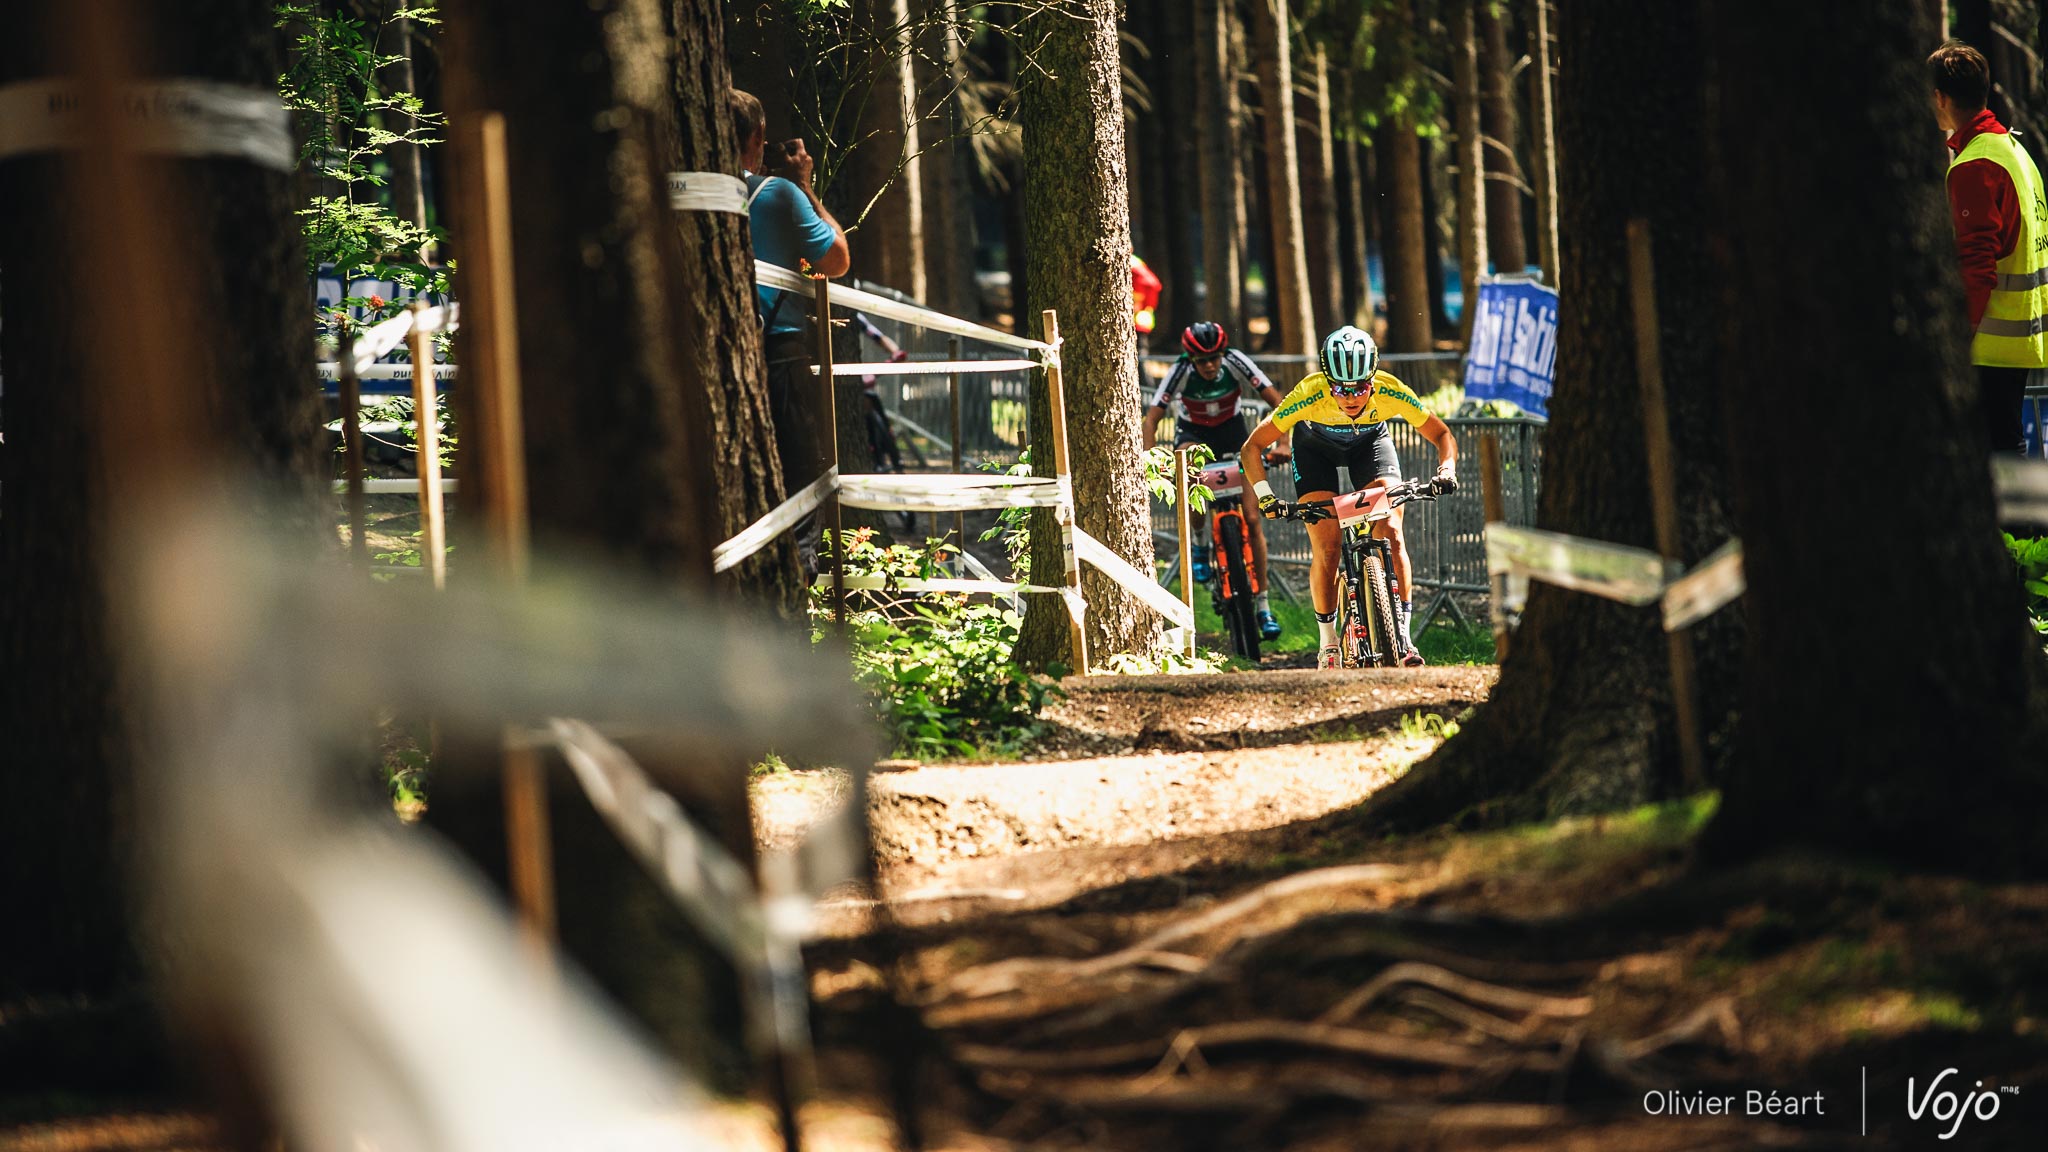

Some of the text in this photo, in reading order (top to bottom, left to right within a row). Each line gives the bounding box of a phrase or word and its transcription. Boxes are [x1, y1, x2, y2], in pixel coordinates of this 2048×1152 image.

[1276, 389, 1325, 420] postnord
[1215, 470, 1228, 485] 3
[1352, 491, 1370, 509] 2
